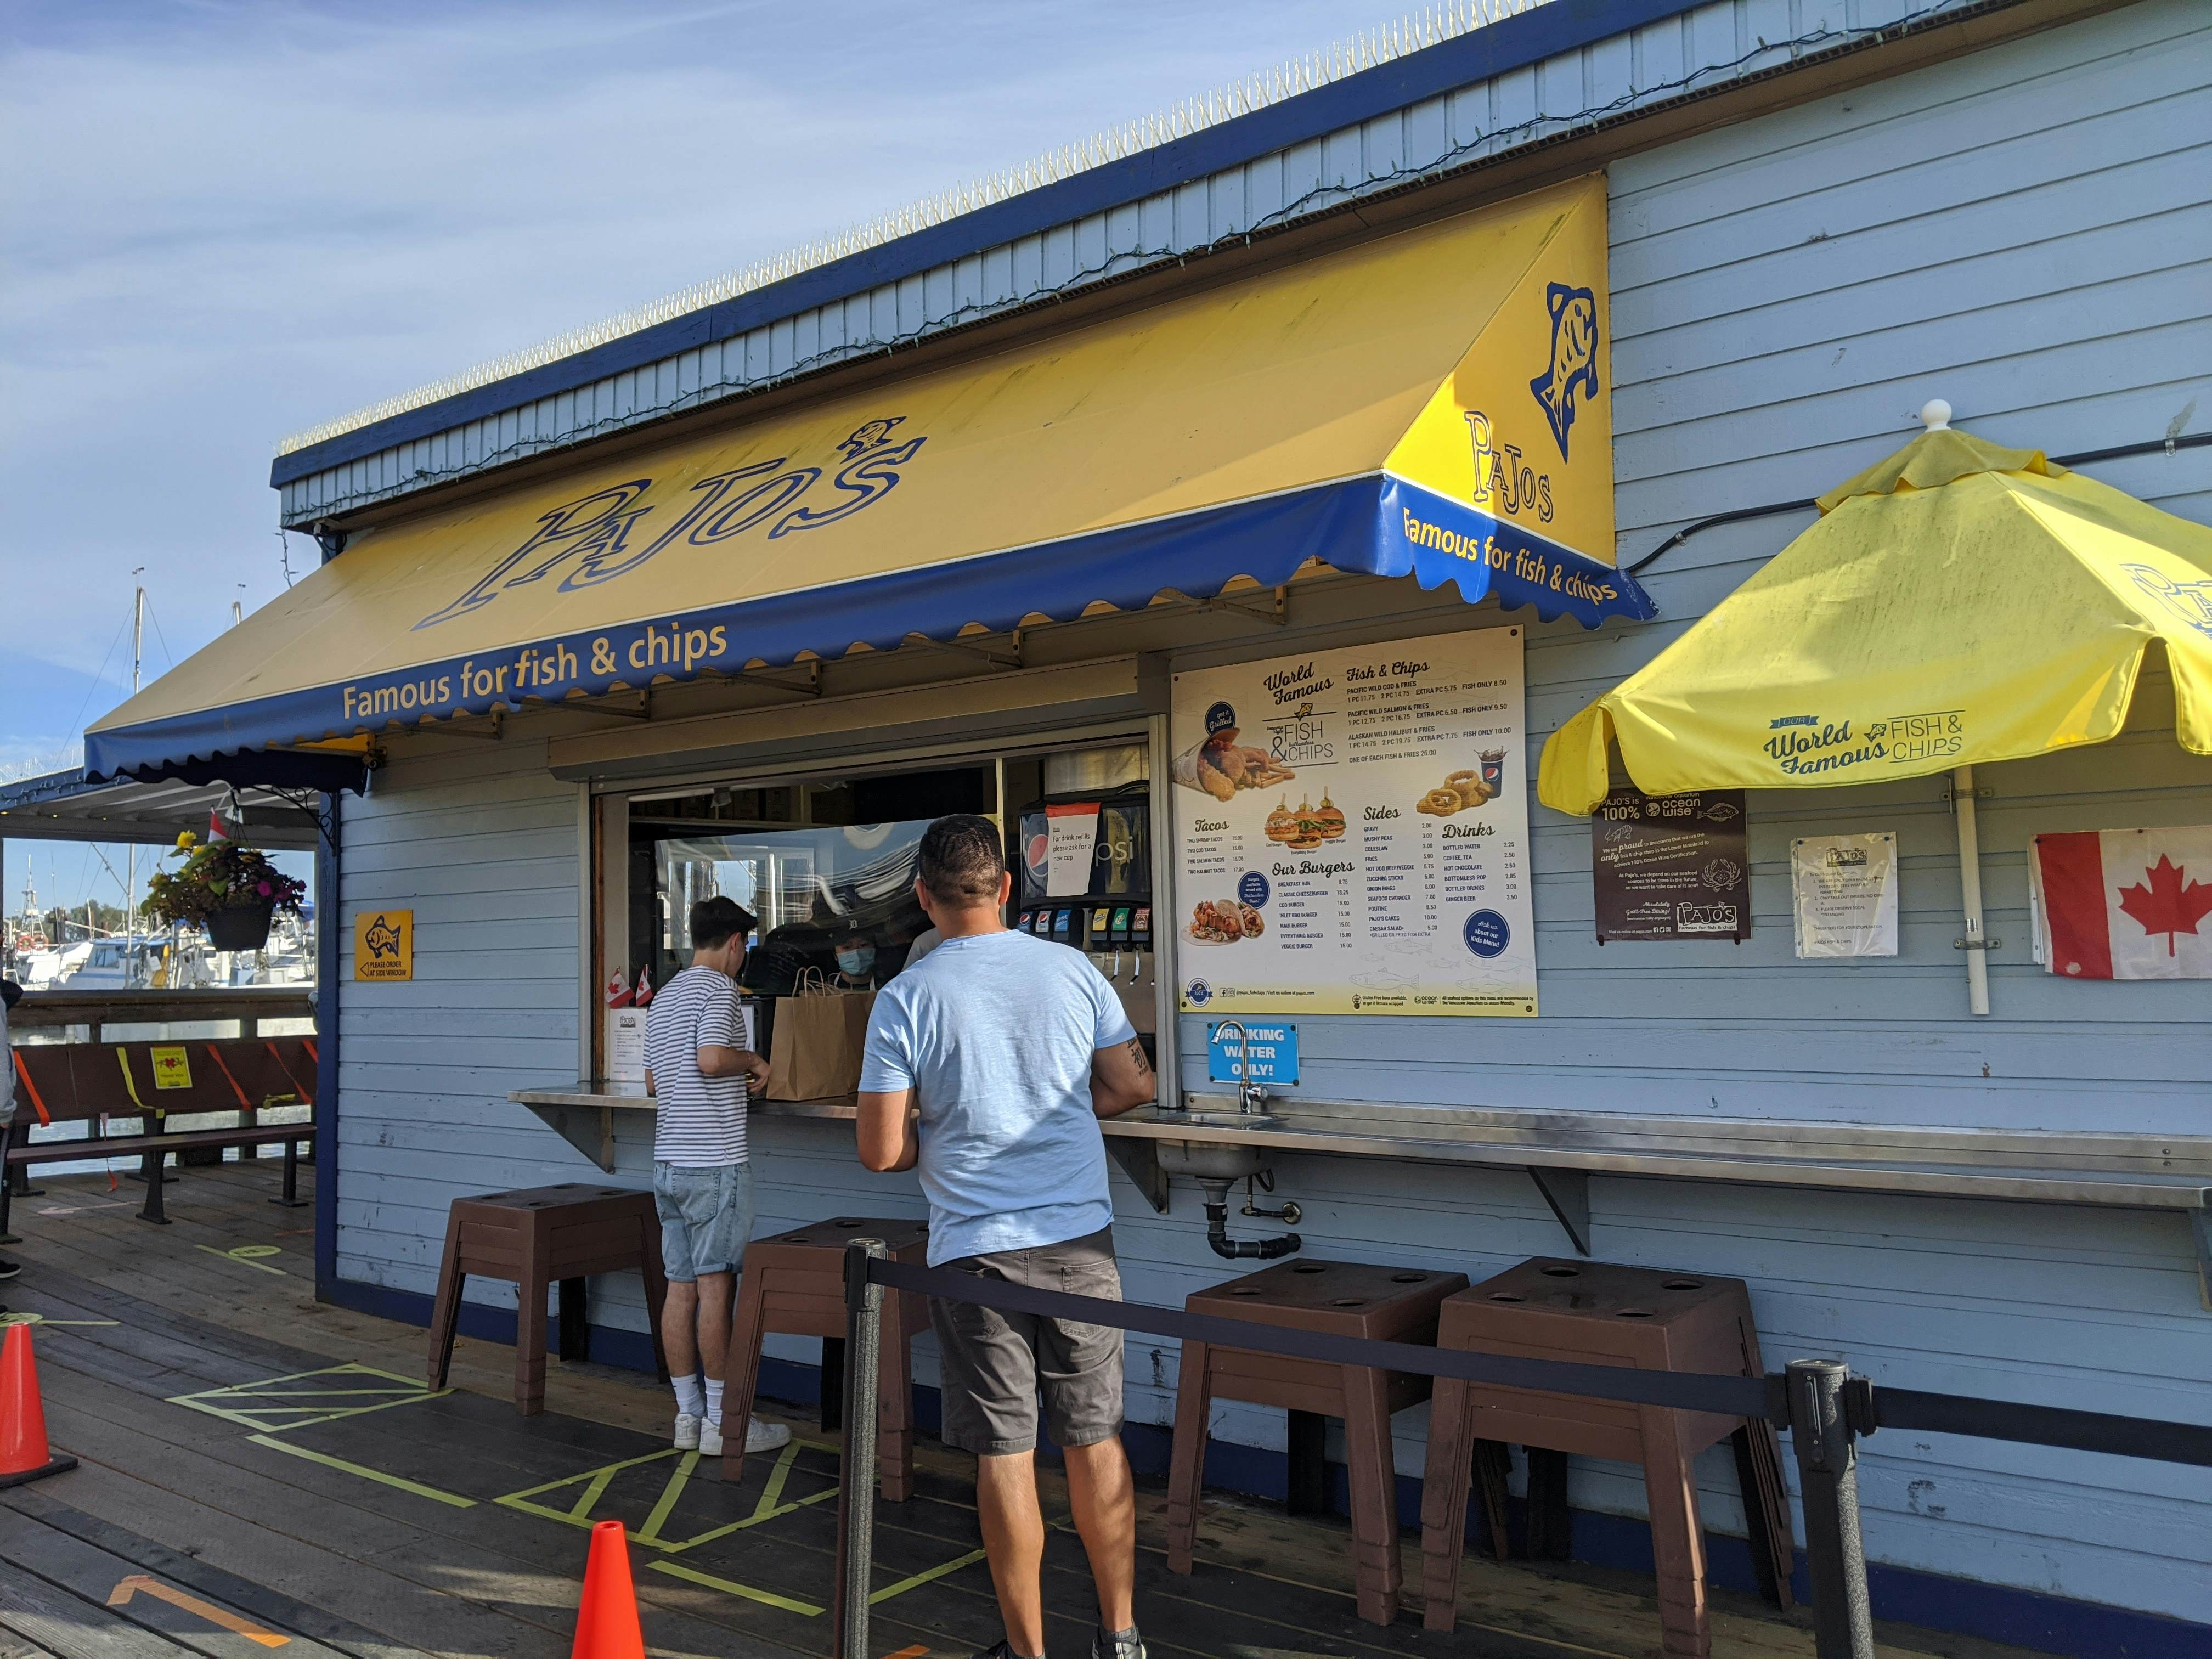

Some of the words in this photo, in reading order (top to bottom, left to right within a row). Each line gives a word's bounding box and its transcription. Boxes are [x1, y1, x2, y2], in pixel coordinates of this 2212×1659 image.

[1403, 507, 1477, 561] Famous
[1484, 535, 1511, 571] for
[1516, 548, 1546, 585] fish
[1550, 566, 1562, 591] &
[1565, 571, 1618, 606] chips
[343, 676, 450, 720] Famous
[460, 662, 507, 698] for
[515, 644, 577, 687] fish
[590, 637, 615, 675] &
[628, 622, 726, 672] chips
[1263, 662, 1314, 691] World
[1347, 666, 1375, 681] Fish
[1379, 664, 1387, 676] &
[1392, 661, 1430, 678] Chips
[1274, 678, 1334, 705] Famous
[1784, 717, 1805, 725] OUR
[1891, 716, 1942, 738] FISH
[1948, 715, 1962, 733] &
[1285, 721, 1323, 742] FISH
[1763, 720, 1853, 759] World
[1271, 736, 1288, 761] &
[1289, 743, 1333, 761] CHIPS
[1893, 736, 1961, 759] CHIPS
[1781, 742, 1889, 774] Famous
[1601, 798, 1630, 806] PAJO'S
[1662, 798, 1700, 808] ocean
[1363, 805, 1401, 820] Sides
[1602, 806, 1640, 821] 100%
[1663, 808, 1691, 816] wise
[1195, 819, 1229, 832] Tacos
[1442, 822, 1496, 838] Drinks
[1272, 862, 1296, 876] Our
[1299, 861, 1355, 878] Burgers
[1475, 928, 1489, 936] about
[1483, 939, 1499, 947] Menu!
